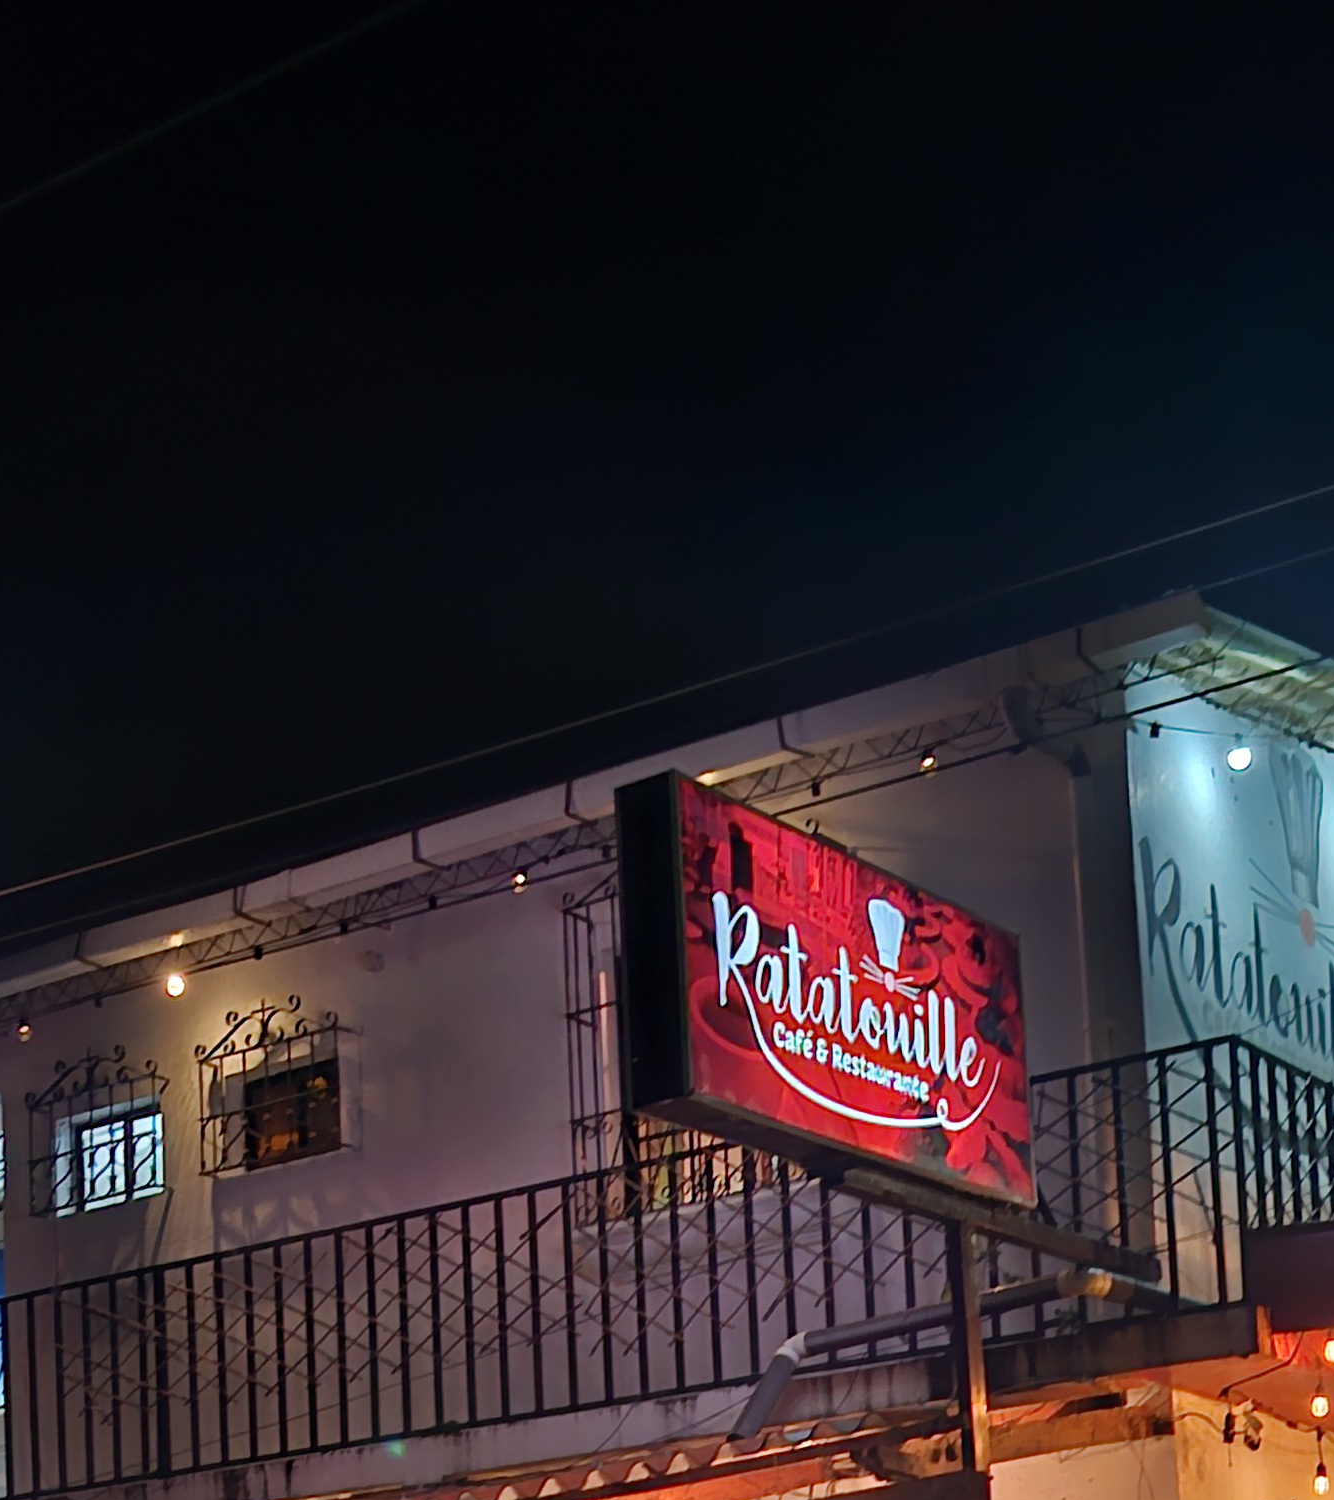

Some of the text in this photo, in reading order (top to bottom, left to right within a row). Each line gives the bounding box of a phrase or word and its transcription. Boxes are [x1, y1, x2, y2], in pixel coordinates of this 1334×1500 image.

[711, 891, 984, 1088] Ratatouille
[773, 1021, 930, 1103] Café & Restaurante
